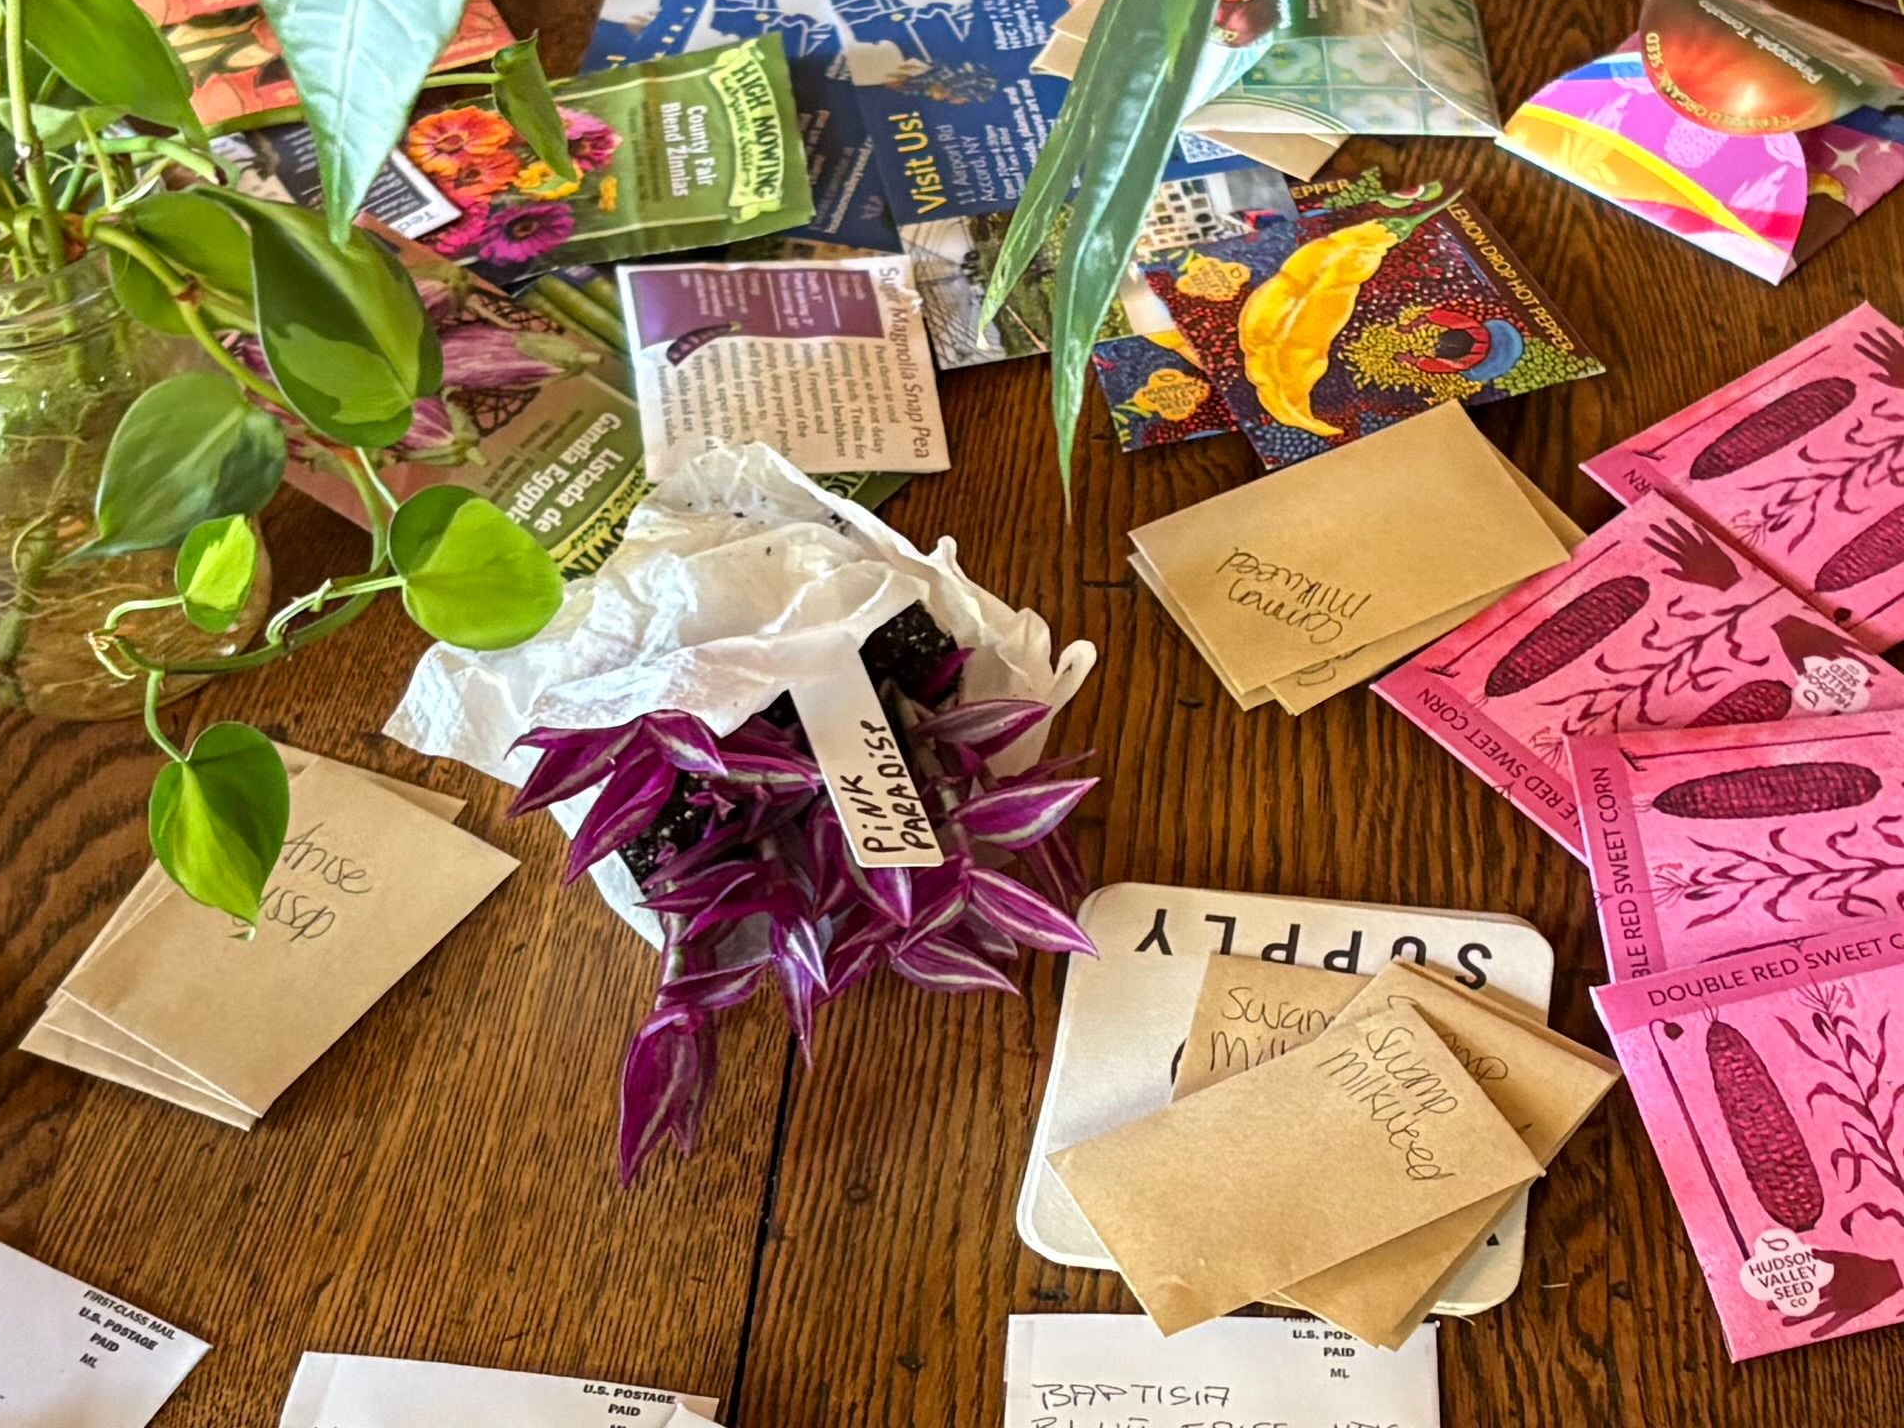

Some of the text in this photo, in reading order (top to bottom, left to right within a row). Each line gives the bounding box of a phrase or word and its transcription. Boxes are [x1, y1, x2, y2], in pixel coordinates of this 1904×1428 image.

[687, 105, 717, 186] County Fair
[730, 60, 780, 198] HIGH MOWING
[961, 136, 981, 155] NY
[661, 102, 692, 196] Blend Zinnias
[888, 110, 947, 214] Visit Us!
[1446, 203, 1574, 351] LEMON DROP HOT PEPPER
[889, 307, 931, 458] Magnolia Snap Pea
[548, 449, 624, 515] Listada
[533, 506, 562, 533] de
[1417, 687, 1565, 809] RED SWEET CORN
[1591, 767, 1644, 940] RED SWEET CORN
[1134, 907, 1494, 992] SUPPLY
[1647, 965, 1748, 1010] DOUBLE
[1751, 955, 1794, 988] RED
[1793, 939, 1881, 980] SWEET
[1365, 1025, 1460, 1117] Swamp
[1748, 1251, 1816, 1276] HUDSON
[1757, 1263, 1817, 1288] VALLEY
[1774, 1281, 1814, 1300] SEED
[1790, 1297, 1808, 1308] CO
[78, 1306, 159, 1351] U.S. POSTAGE
[81, 1288, 179, 1341] FIRST-CLASS MAIL
[88, 1331, 121, 1352] PAID
[1291, 1328, 1322, 1344] U.S.
[1322, 1345, 1357, 1360] PAID
[80, 1352, 101, 1370] ML
[1329, 1366, 1350, 1380] ML
[582, 1383, 676, 1406] U.S. POSTAGE
[607, 1403, 641, 1419] PAID
[1031, 1383, 1231, 1411] BAPTISIA
